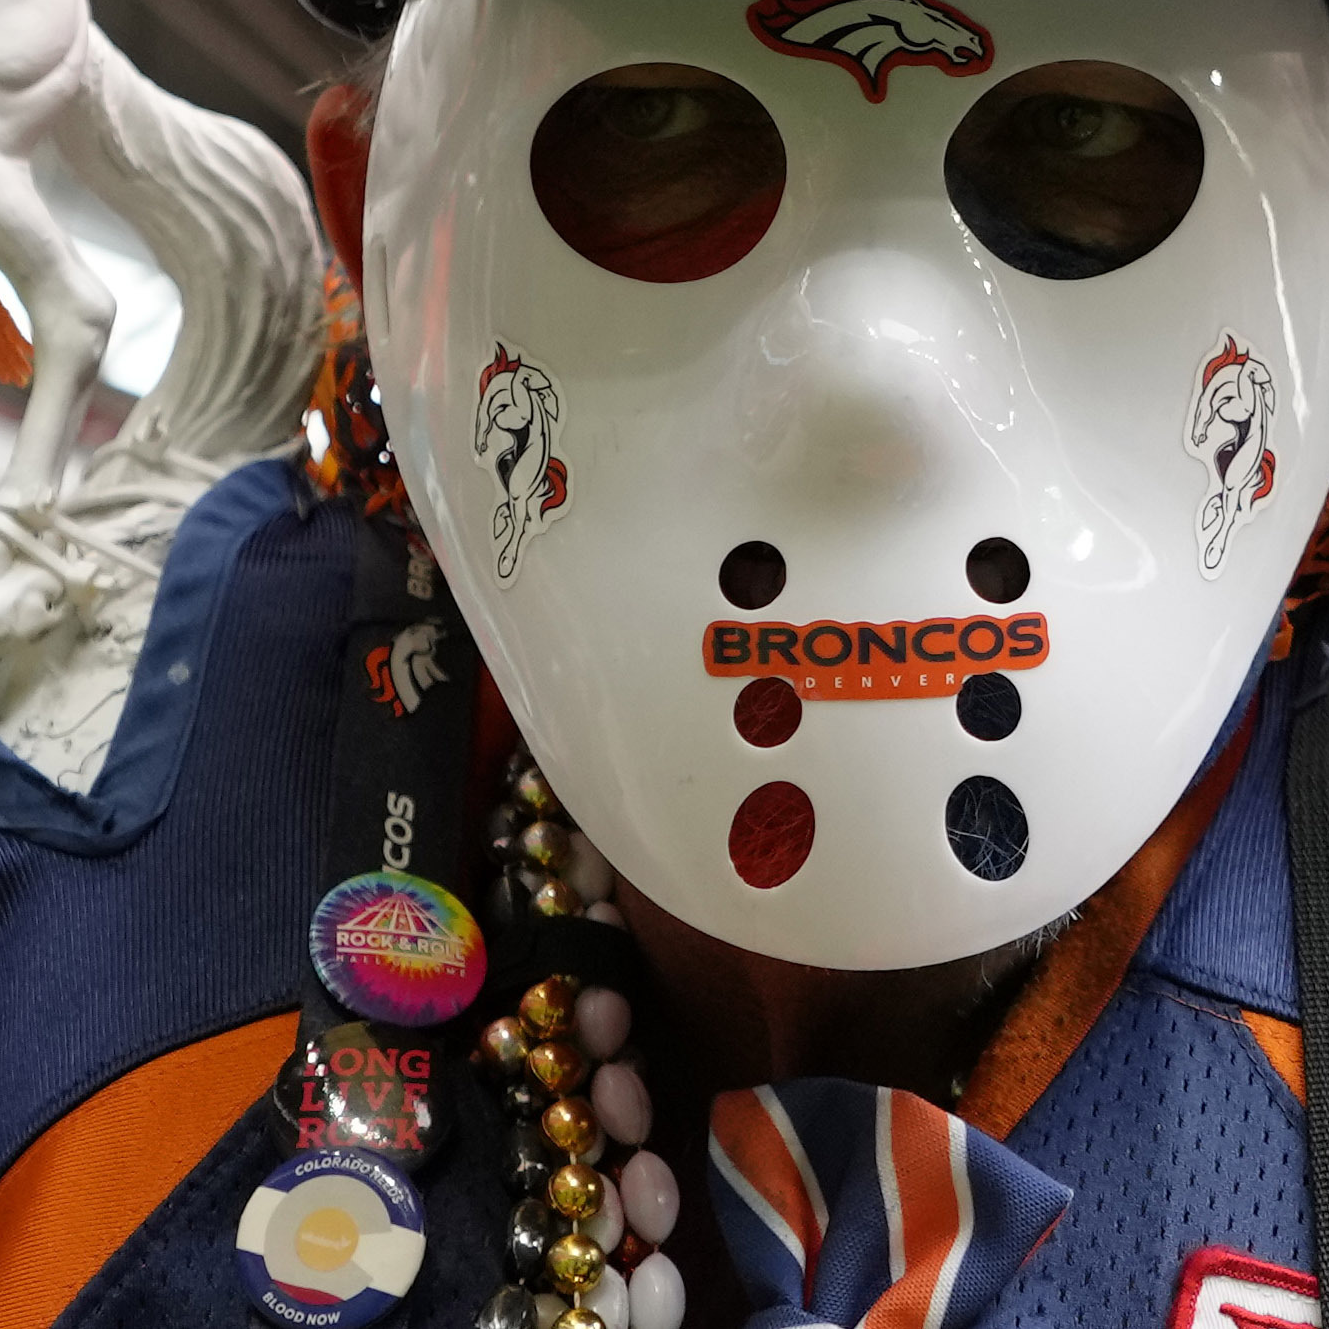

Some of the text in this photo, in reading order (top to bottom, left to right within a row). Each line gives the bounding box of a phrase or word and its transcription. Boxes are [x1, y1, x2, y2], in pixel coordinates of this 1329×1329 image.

[712, 618, 1044, 666] BRONCOS
[805, 673, 956, 689] DENVER
[382, 791, 414, 872] COS
[336, 932, 465, 962] ROCK & ROLL
[303, 1048, 431, 1079] LONG
[299, 1082, 428, 1113] LIVE
[296, 1117, 424, 1150] ROCK
[295, 1156, 404, 1205] COLORADO NEEDS
[262, 1292, 341, 1326] BLOOD NOW
